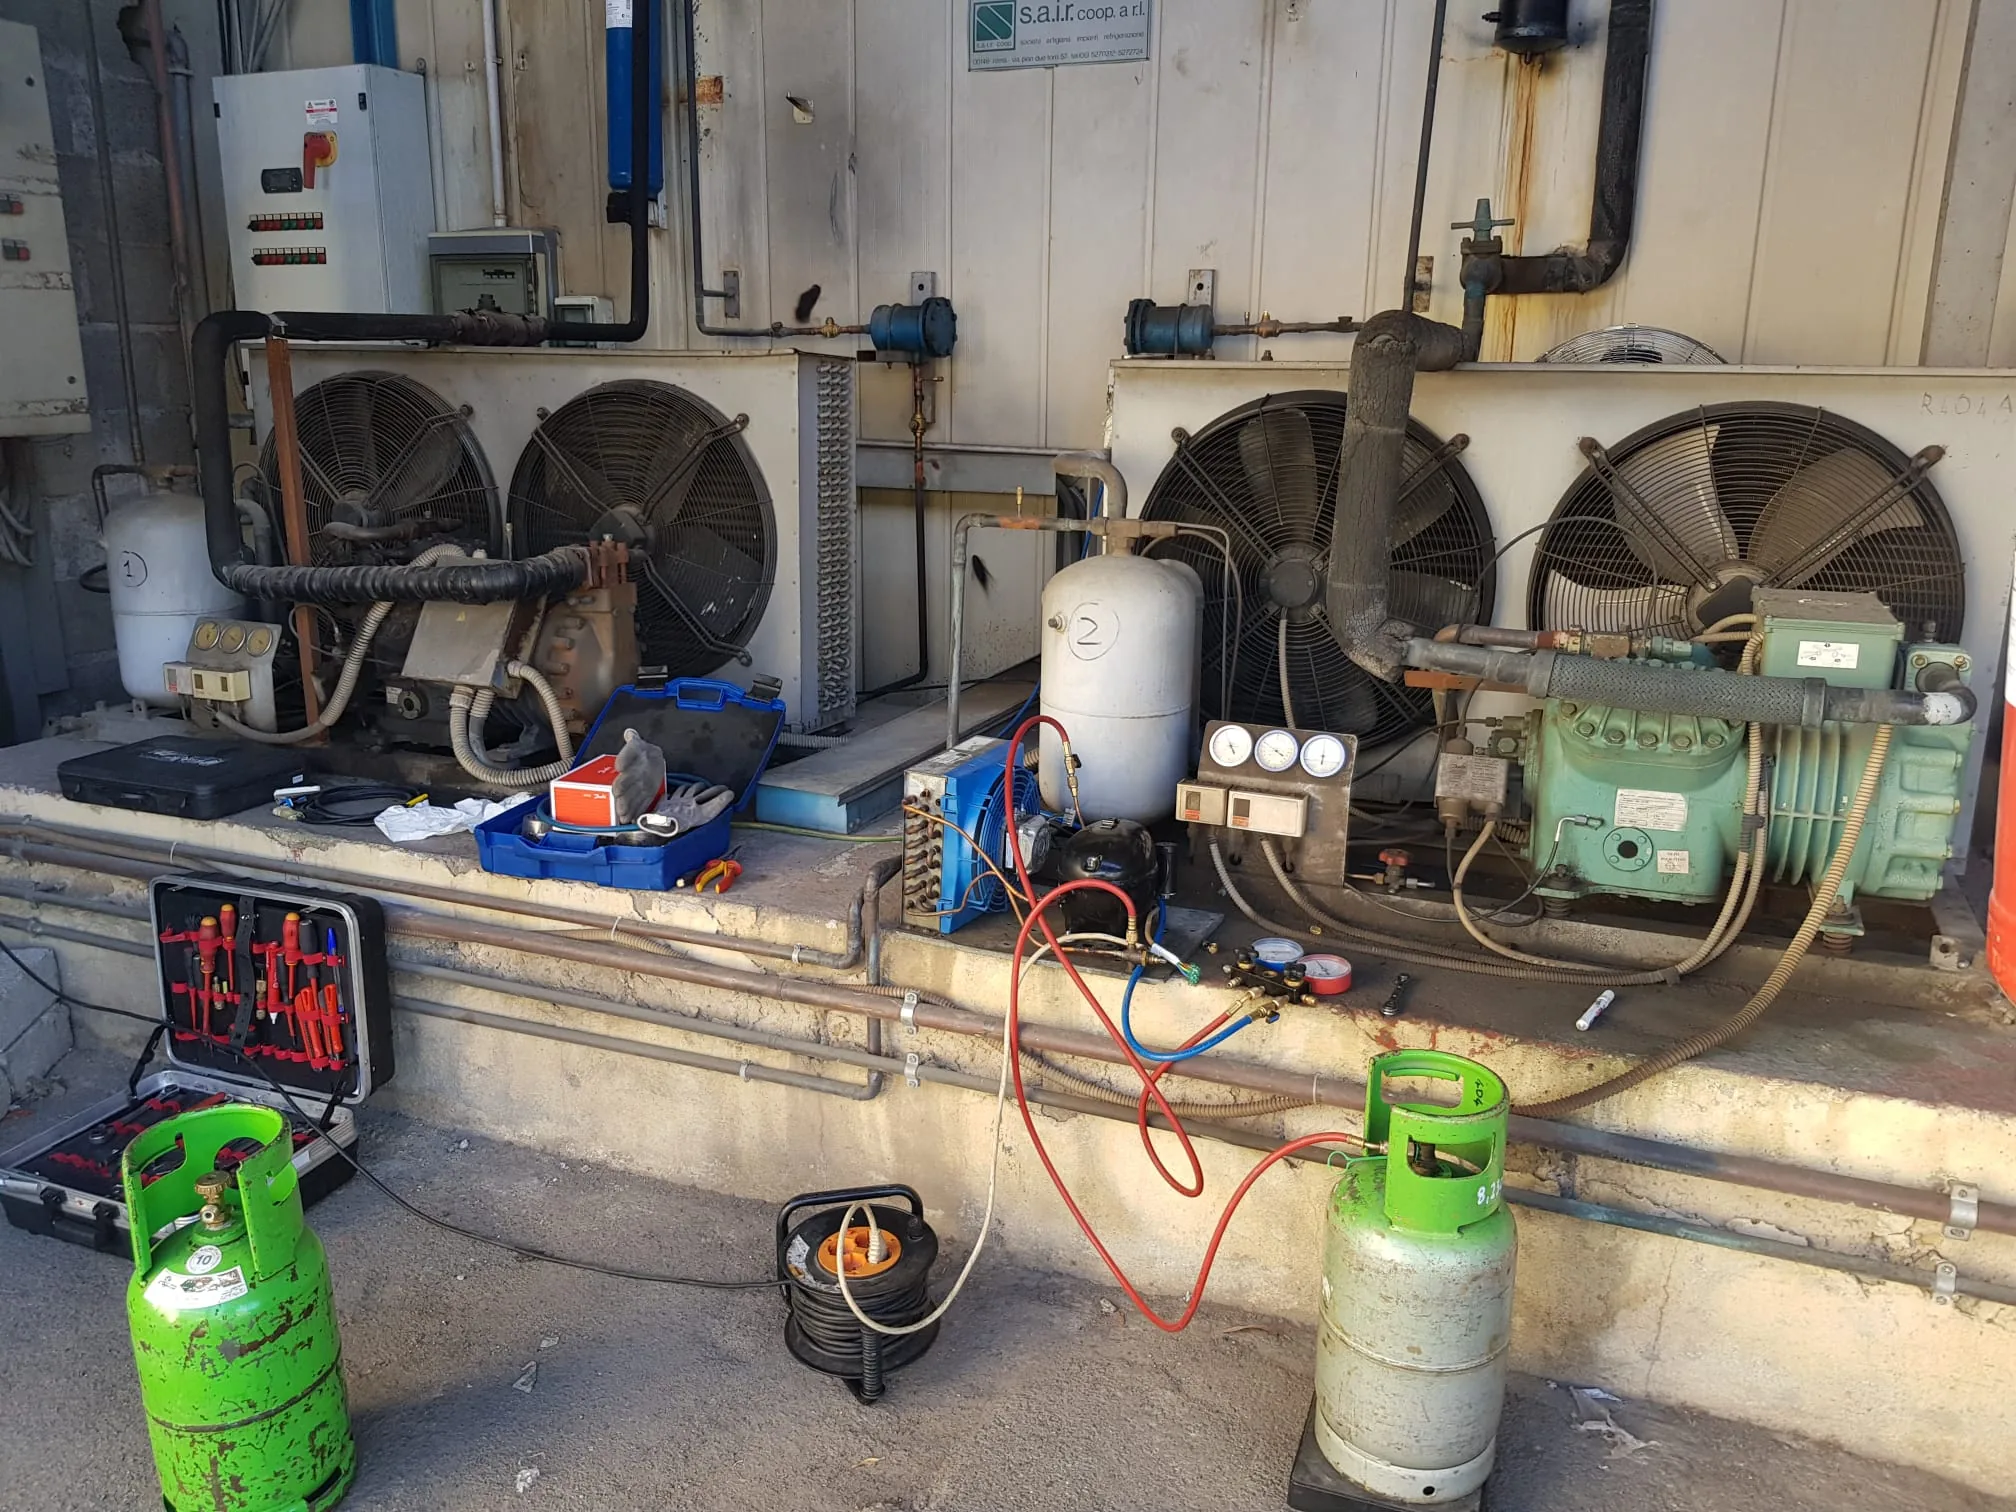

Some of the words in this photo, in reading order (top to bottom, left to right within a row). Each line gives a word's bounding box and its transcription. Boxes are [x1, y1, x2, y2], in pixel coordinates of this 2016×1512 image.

[1019, 0, 1075, 24] s.a.i.r.
[1077, 6, 1116, 21] coop.
[1120, 6, 1128, 17] a
[1077, 616, 1102, 646] 2
[197, 1254, 212, 1265] 10
